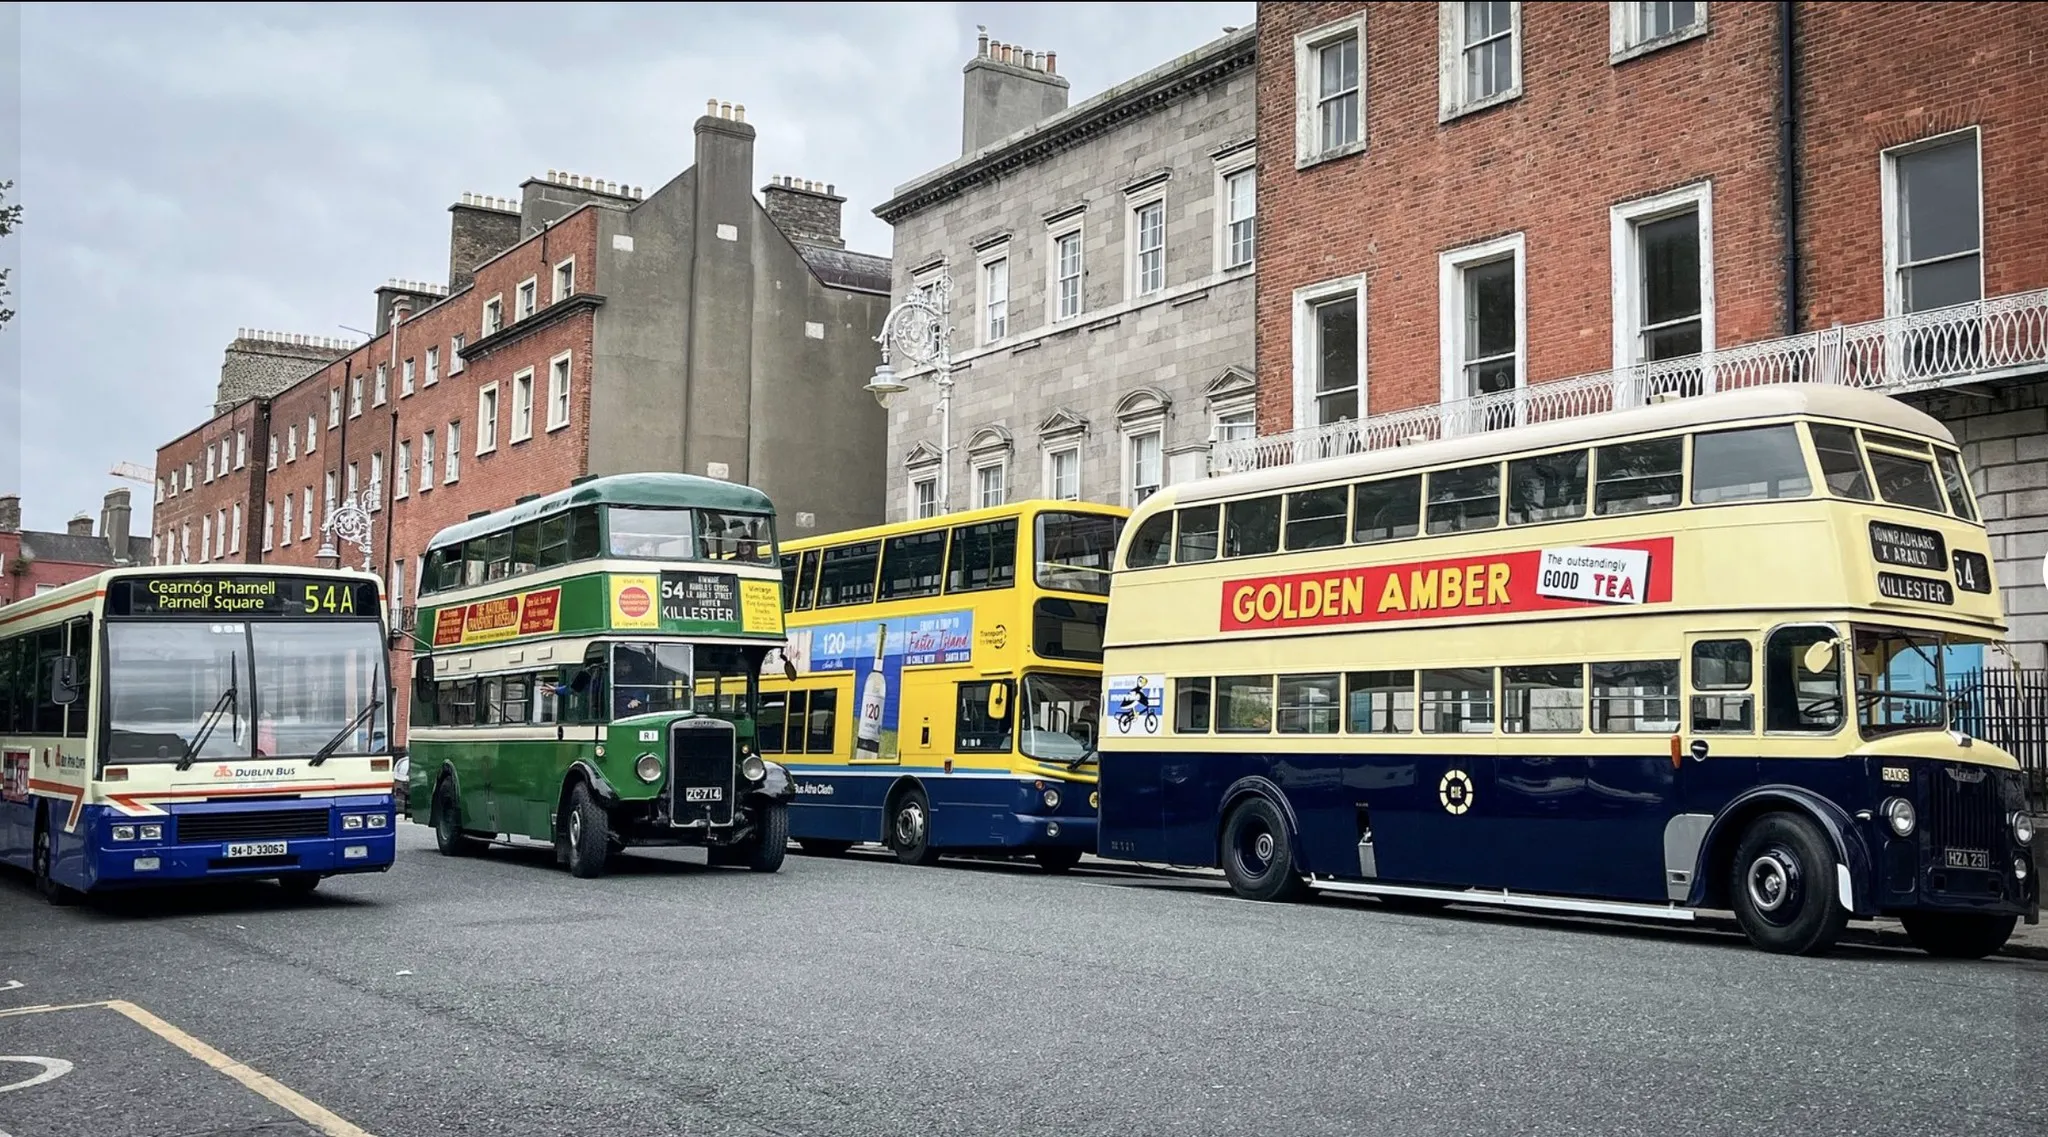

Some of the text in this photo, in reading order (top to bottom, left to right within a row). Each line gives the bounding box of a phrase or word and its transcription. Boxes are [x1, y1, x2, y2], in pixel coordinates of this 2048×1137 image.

[1872, 526, 1935, 550] IONNRADHARC
[1548, 554, 1626, 572] The outstandingly
[1894, 548, 1928, 566] ARAILD
[149, 580, 276, 597] Cearnóg Pharnell
[662, 580, 684, 600] 54
[1232, 562, 1511, 623] GOLDEN AMBER
[1543, 570, 1634, 600] GOOD TEA
[1880, 576, 1946, 602] KILLESTER
[159, 595, 264, 612] Parnell Square
[304, 585, 354, 614] 54A
[714, 592, 733, 600] STREET
[662, 606, 734, 621] KILLESTER
[823, 632, 846, 655] 120
[909, 629, 969, 654] Easter Island
[866, 703, 880, 721] 120
[235, 768, 296, 777] DUBLIN BUS
[1884, 768, 1909, 781] RA106
[818, 784, 834, 795] Cliath
[231, 844, 285, 856] 94-D-33063
[1948, 851, 1986, 868] HZA 231
